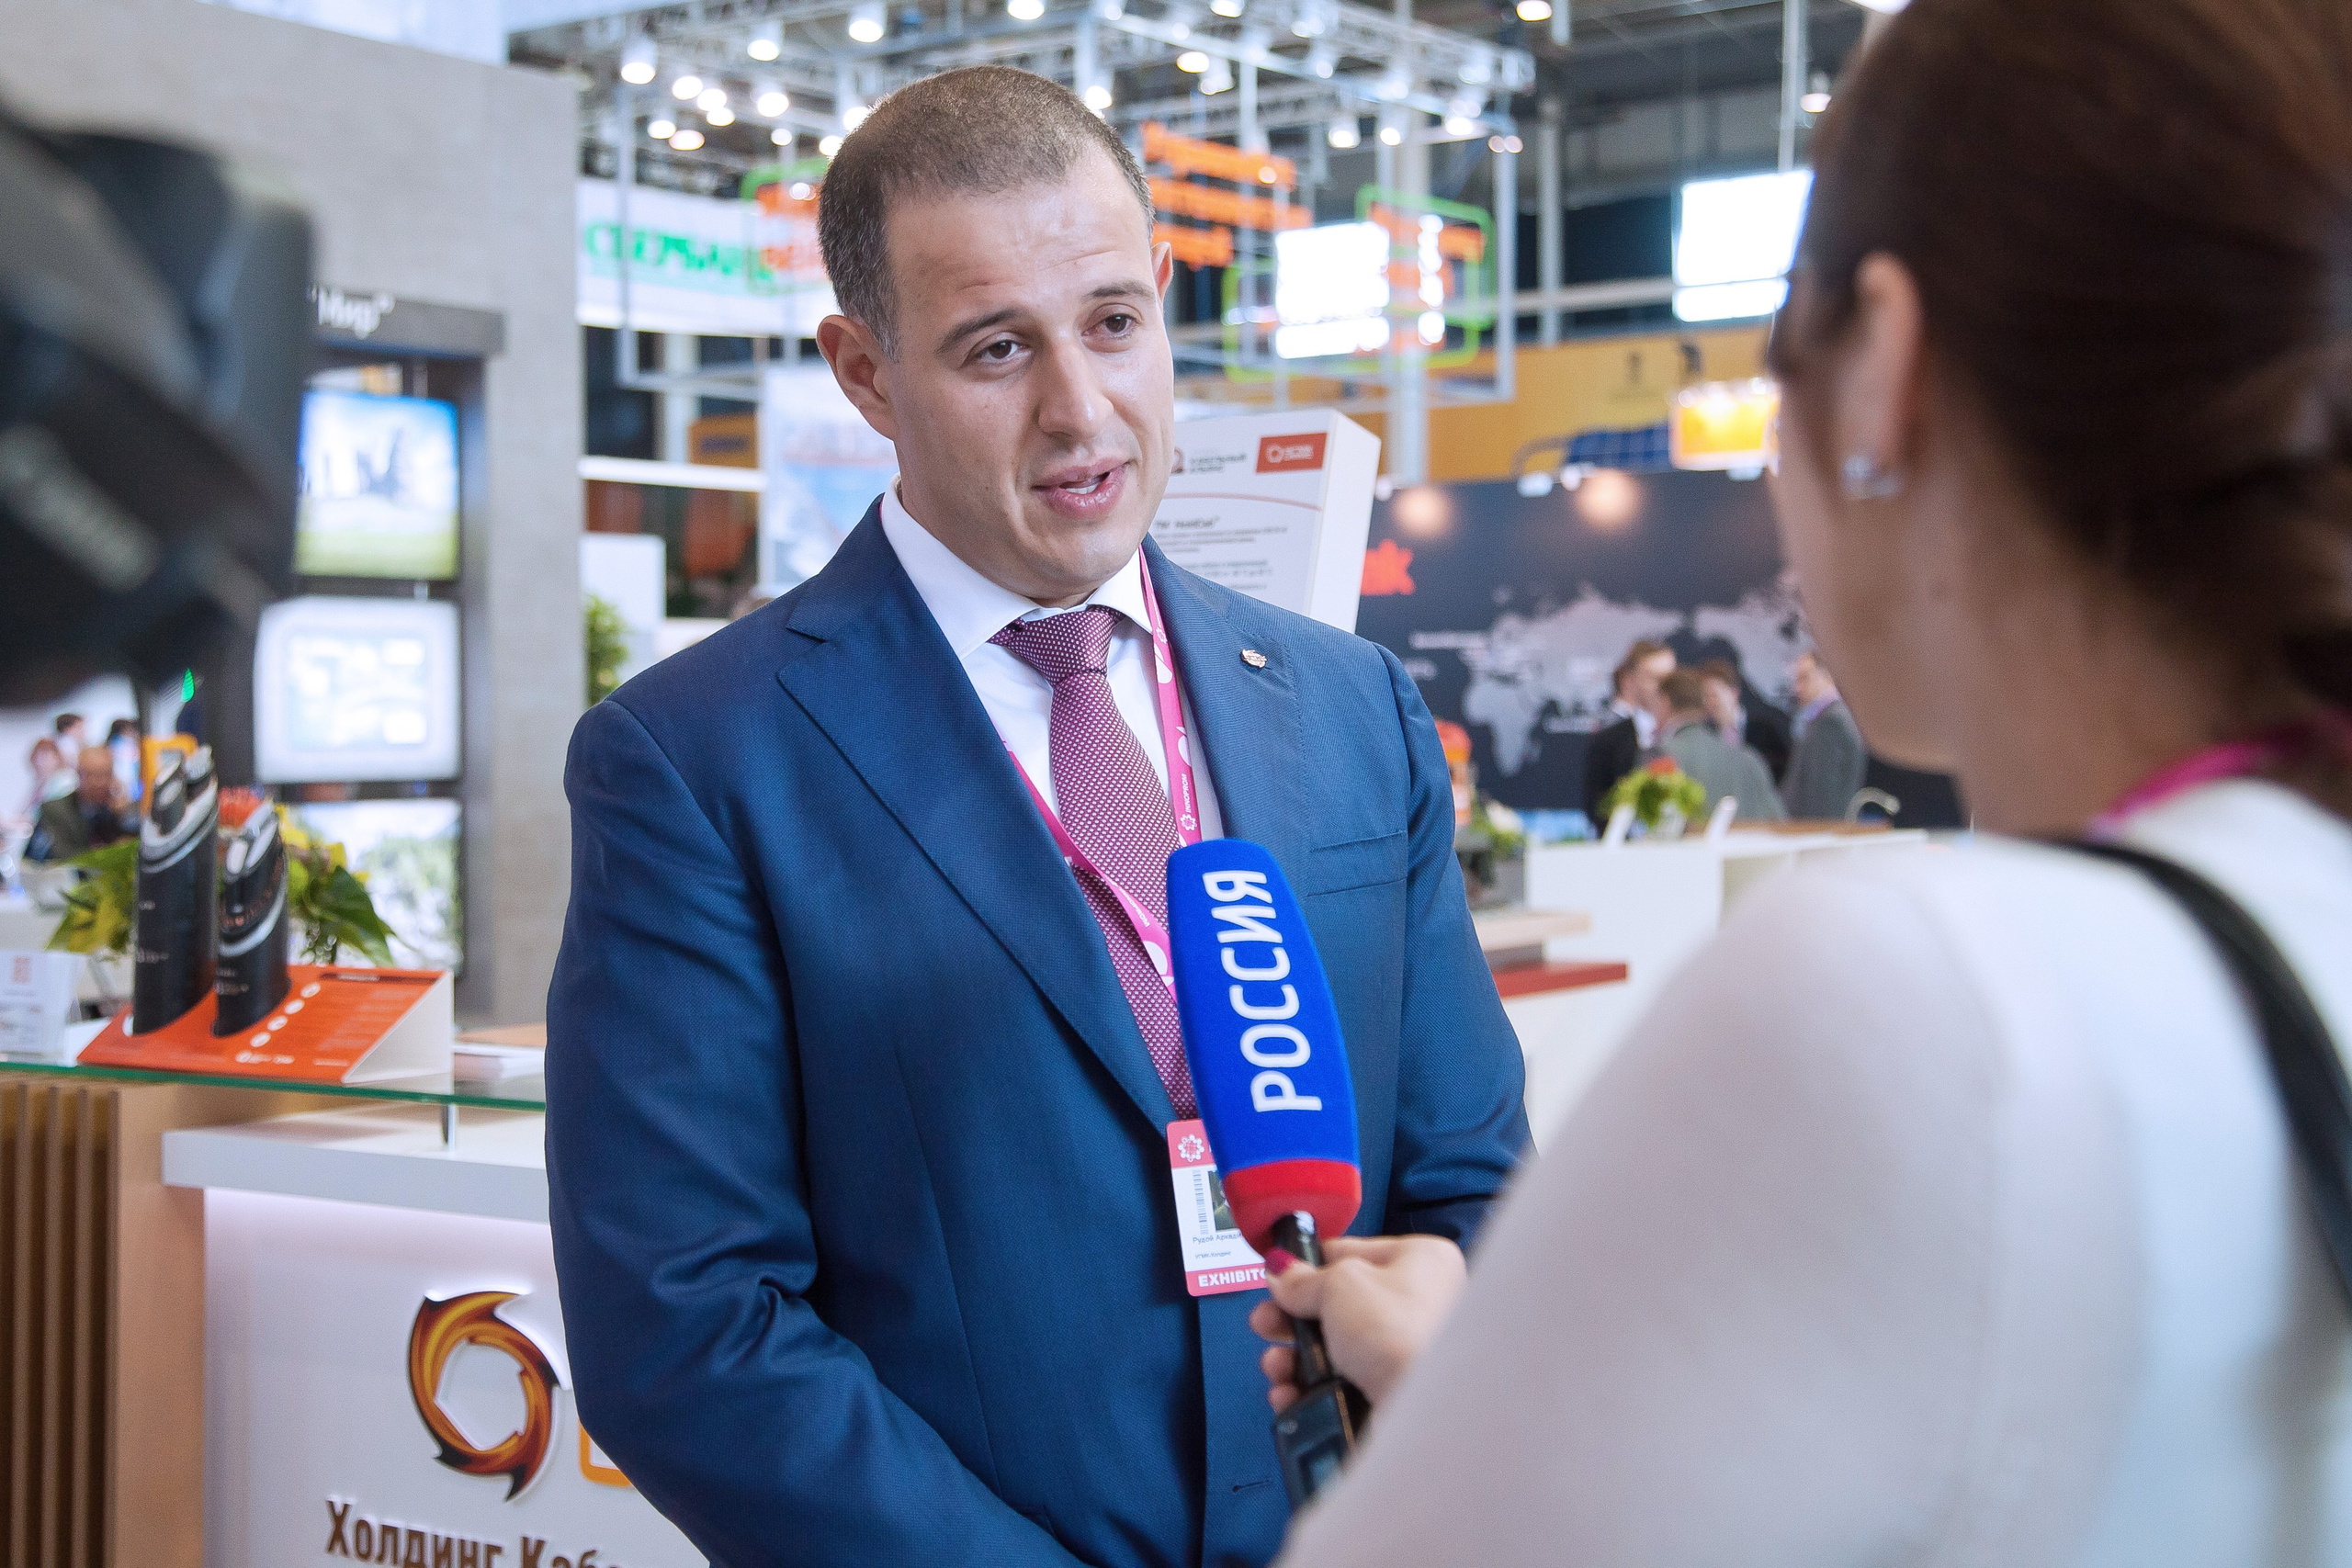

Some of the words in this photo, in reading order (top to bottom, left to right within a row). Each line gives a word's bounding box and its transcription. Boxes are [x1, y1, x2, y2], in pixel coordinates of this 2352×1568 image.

[1181, 773, 1192, 814] INNOPROM
[1202, 870, 1323, 1112] РОССИЯ
[325, 1499, 503, 1568] Холдинг
